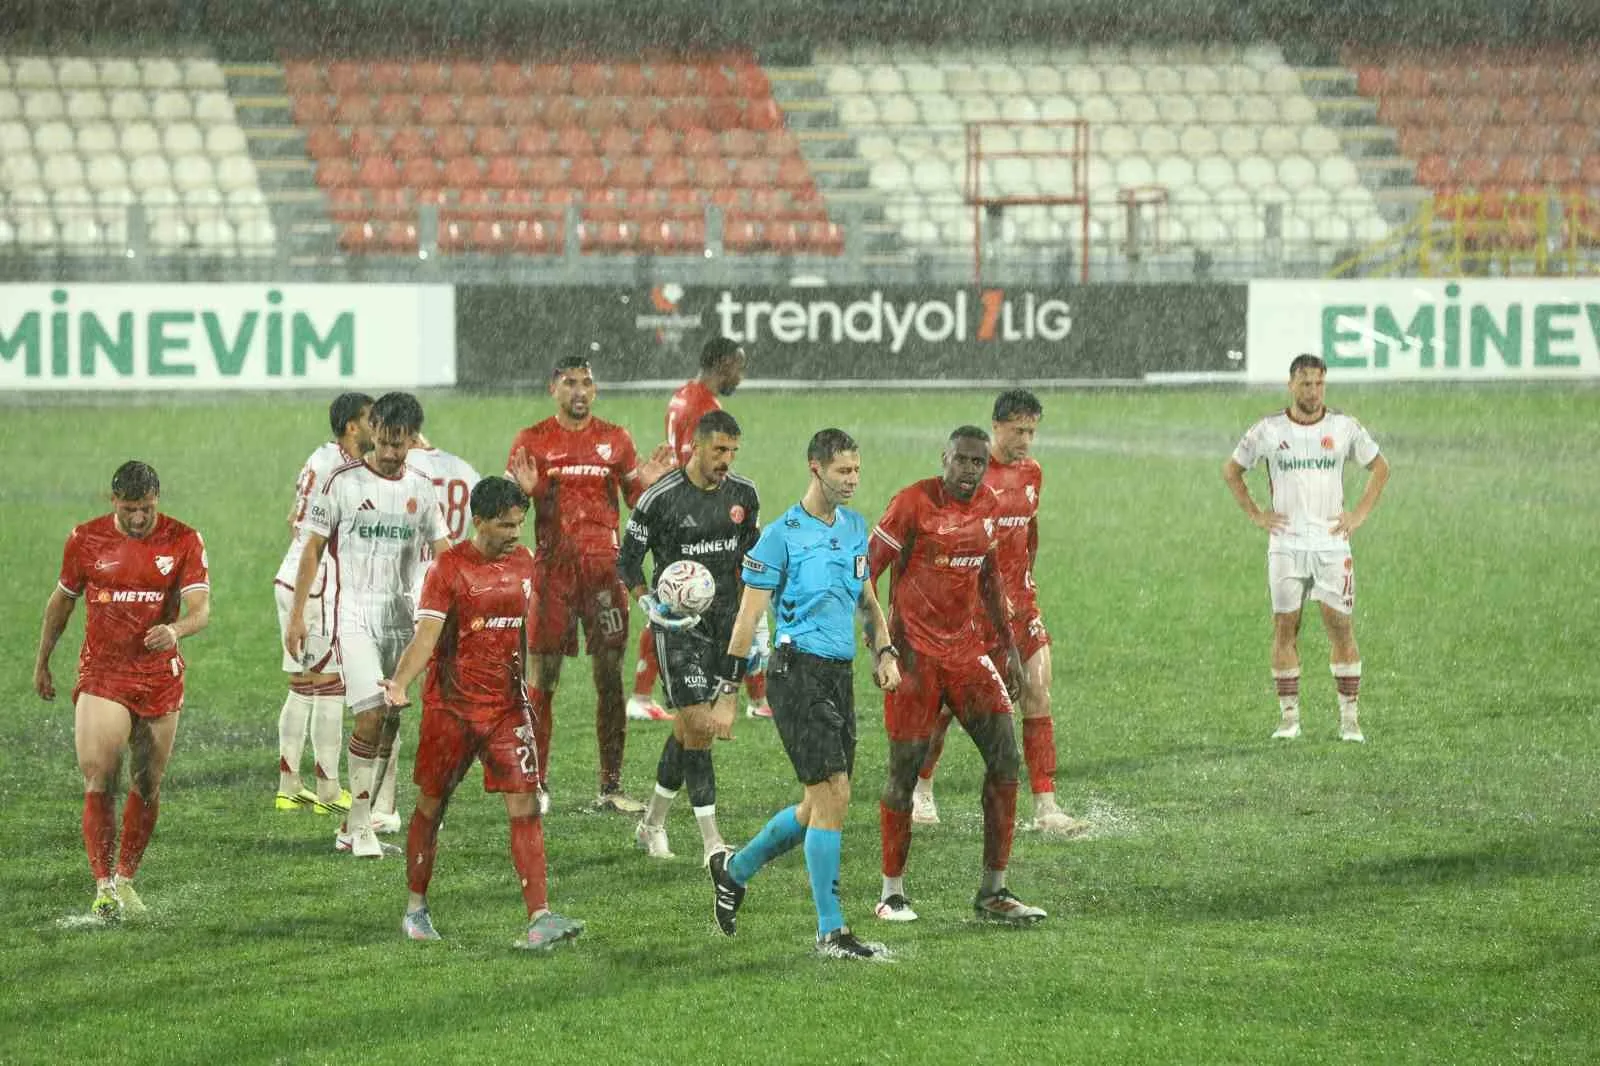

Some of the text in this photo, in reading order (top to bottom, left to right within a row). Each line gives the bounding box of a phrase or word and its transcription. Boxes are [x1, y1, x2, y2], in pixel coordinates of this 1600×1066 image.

[715, 289, 968, 353] trendyol
[561, 464, 611, 477] METRO
[998, 515, 1032, 529] METR
[950, 555, 986, 569] METR
[484, 615, 523, 629] METR
